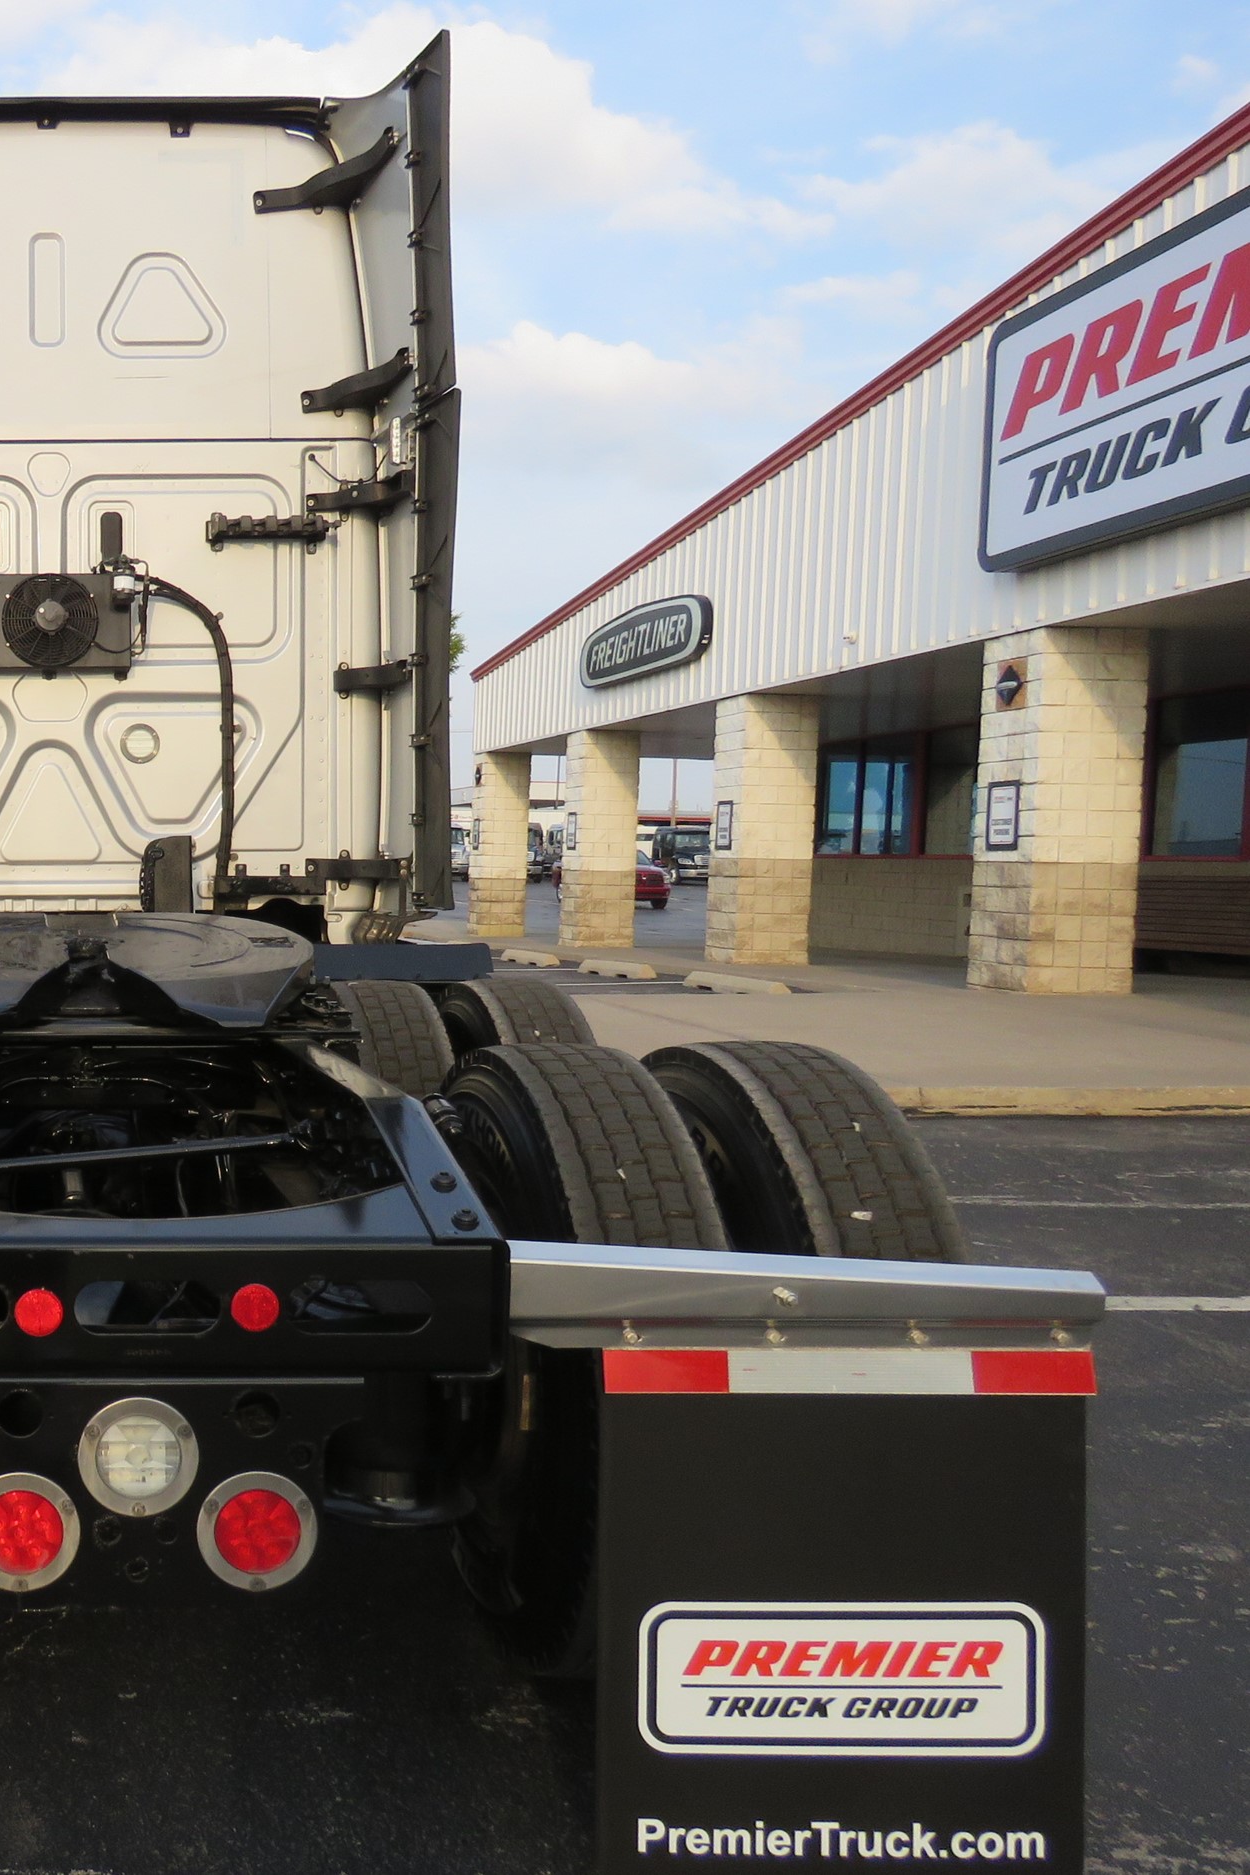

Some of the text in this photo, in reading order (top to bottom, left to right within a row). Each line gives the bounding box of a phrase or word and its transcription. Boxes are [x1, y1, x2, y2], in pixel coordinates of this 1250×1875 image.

[1023, 396, 1223, 516] TRUCK
[589, 613, 687, 673] FREIGHTLINER
[682, 1640, 1004, 1678] PREMIER
[704, 1696, 979, 1719] TRUCK GROUP
[636, 1818, 1045, 1858] PremierTruck.com
